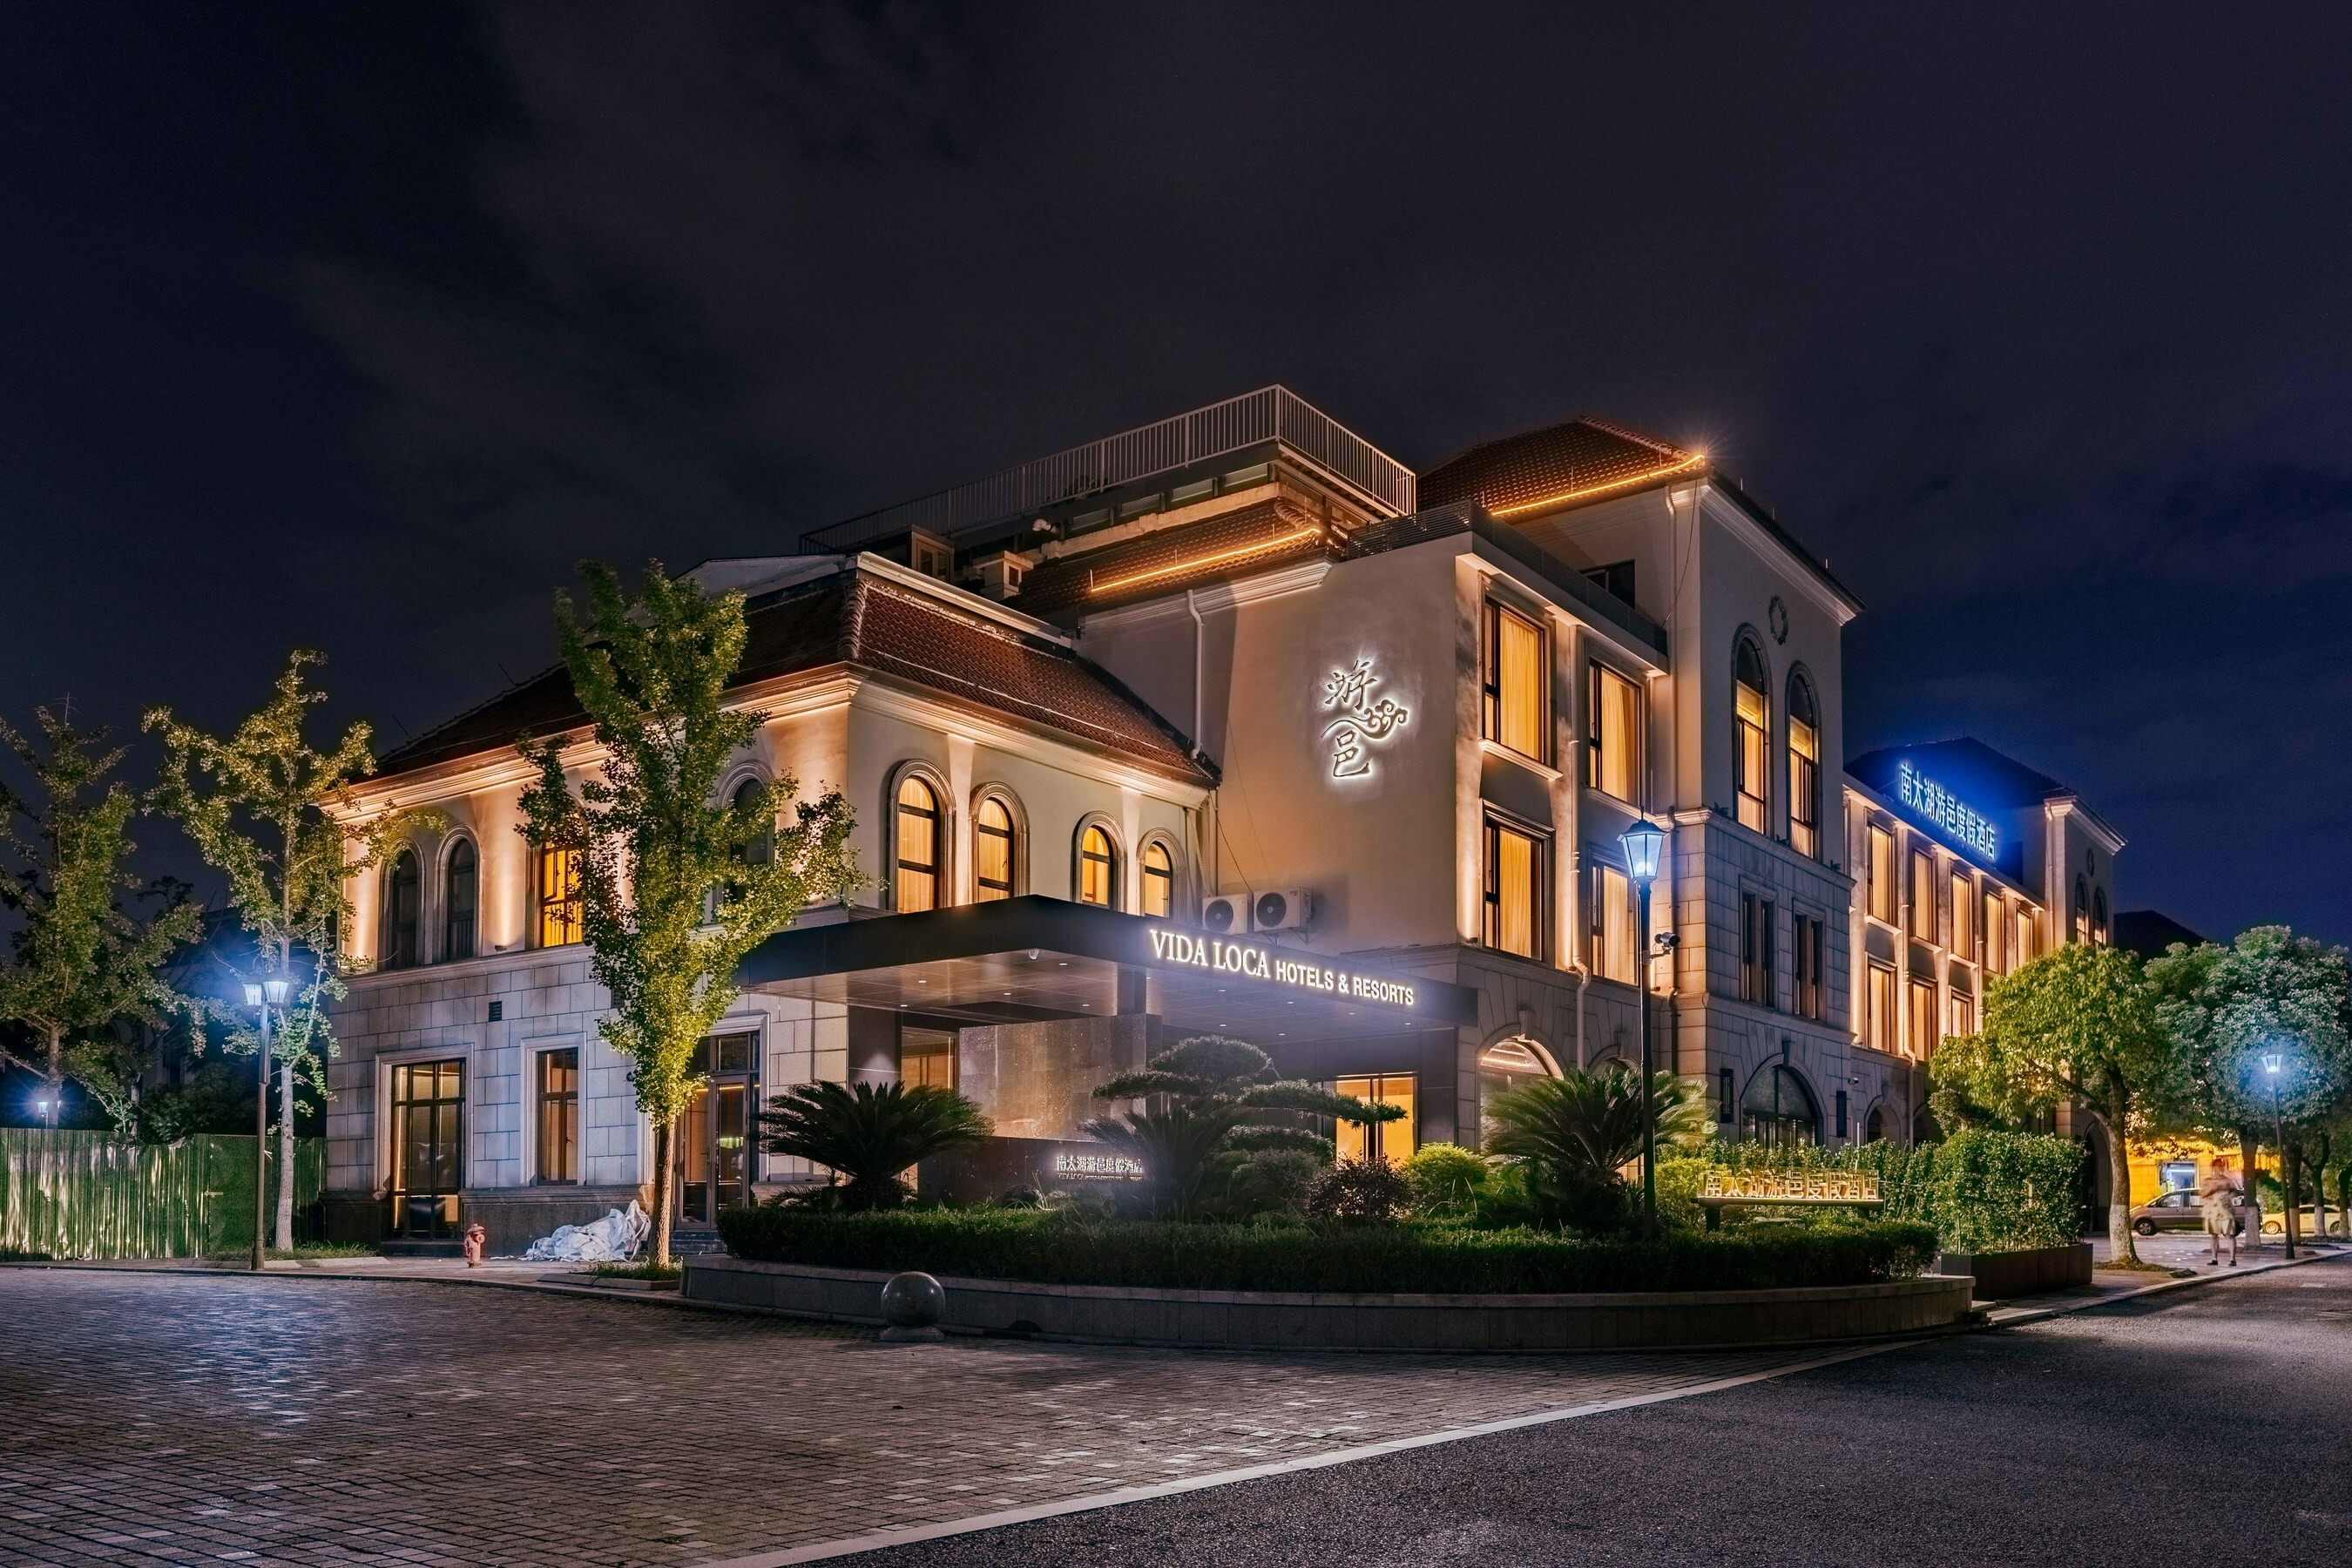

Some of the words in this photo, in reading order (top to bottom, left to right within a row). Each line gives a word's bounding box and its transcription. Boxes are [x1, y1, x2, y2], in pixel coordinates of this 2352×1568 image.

[1901, 763, 1996, 860] 南太湖游邑度假酒店
[1149, 929, 1208, 967] VIDA
[1213, 941, 1271, 978] LOCA
[1275, 960, 1335, 990] HOTELS
[1338, 974, 1349, 994] &
[1353, 976, 1414, 1006] RESORTS
